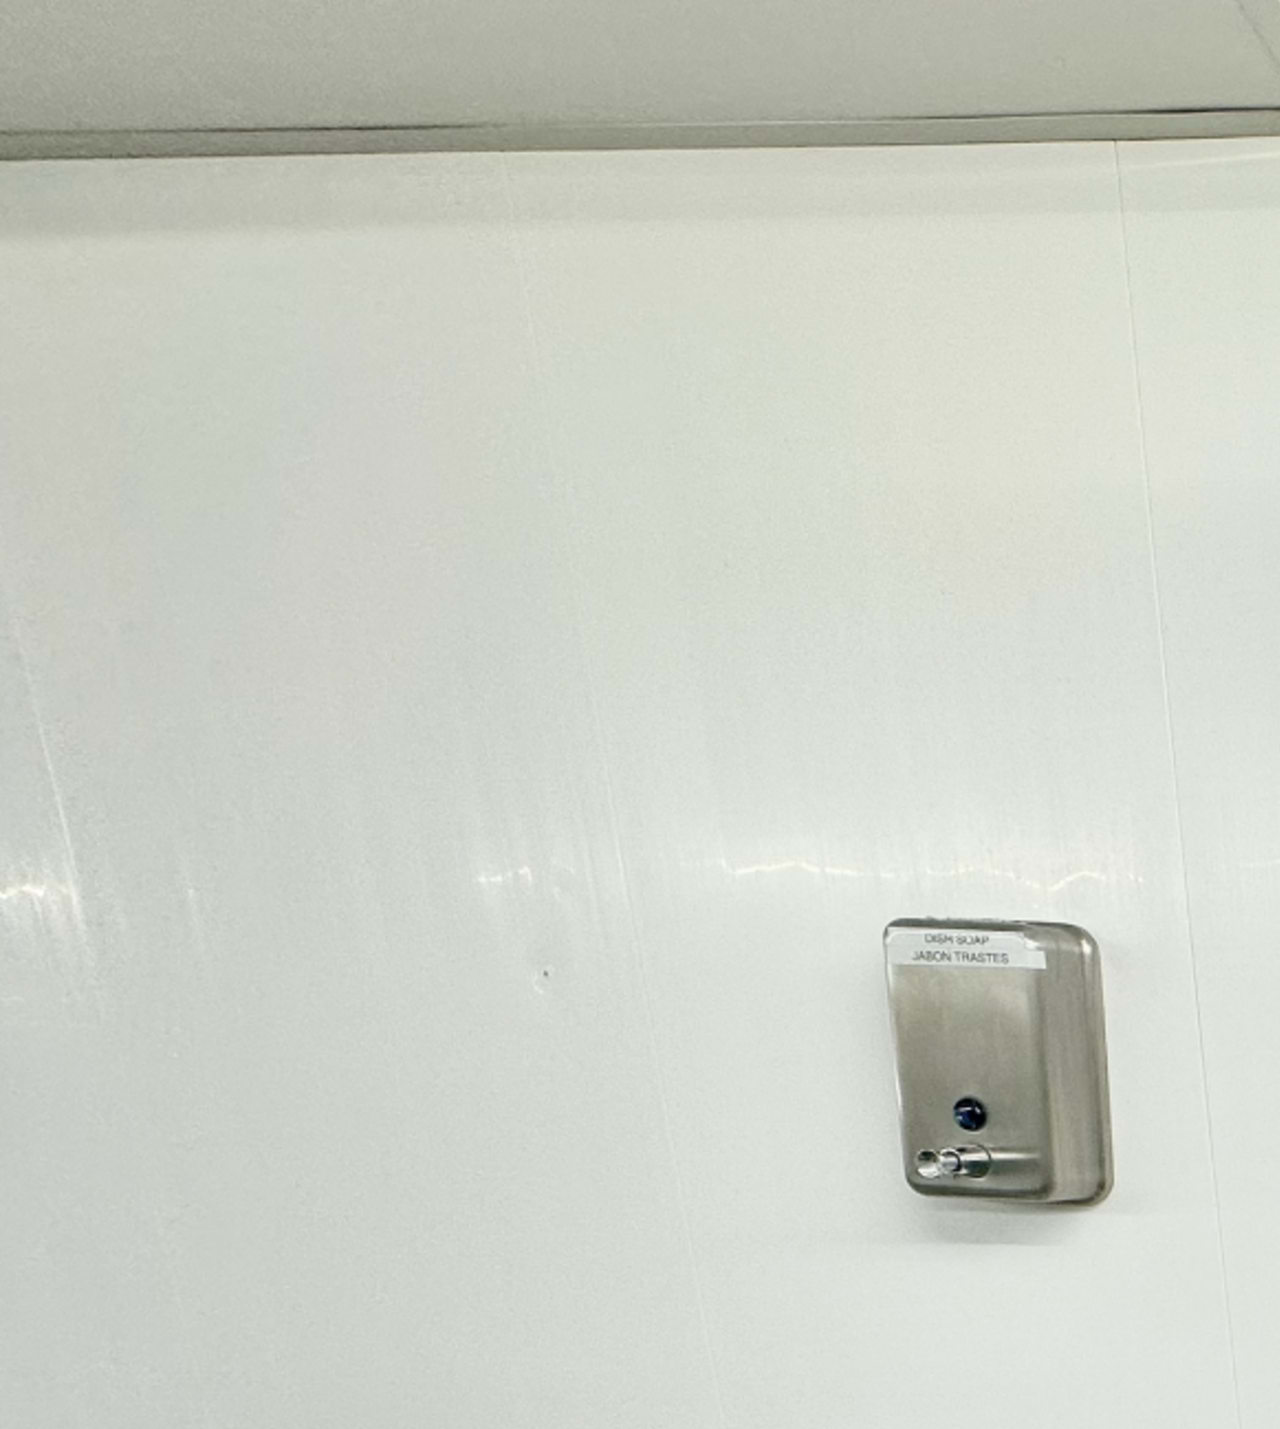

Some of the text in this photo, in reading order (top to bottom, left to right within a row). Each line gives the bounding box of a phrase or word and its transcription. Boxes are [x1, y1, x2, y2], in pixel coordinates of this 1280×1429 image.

[924, 932, 989, 946] DISH SOAP
[912, 950, 1009, 964] JABON TRASTES
